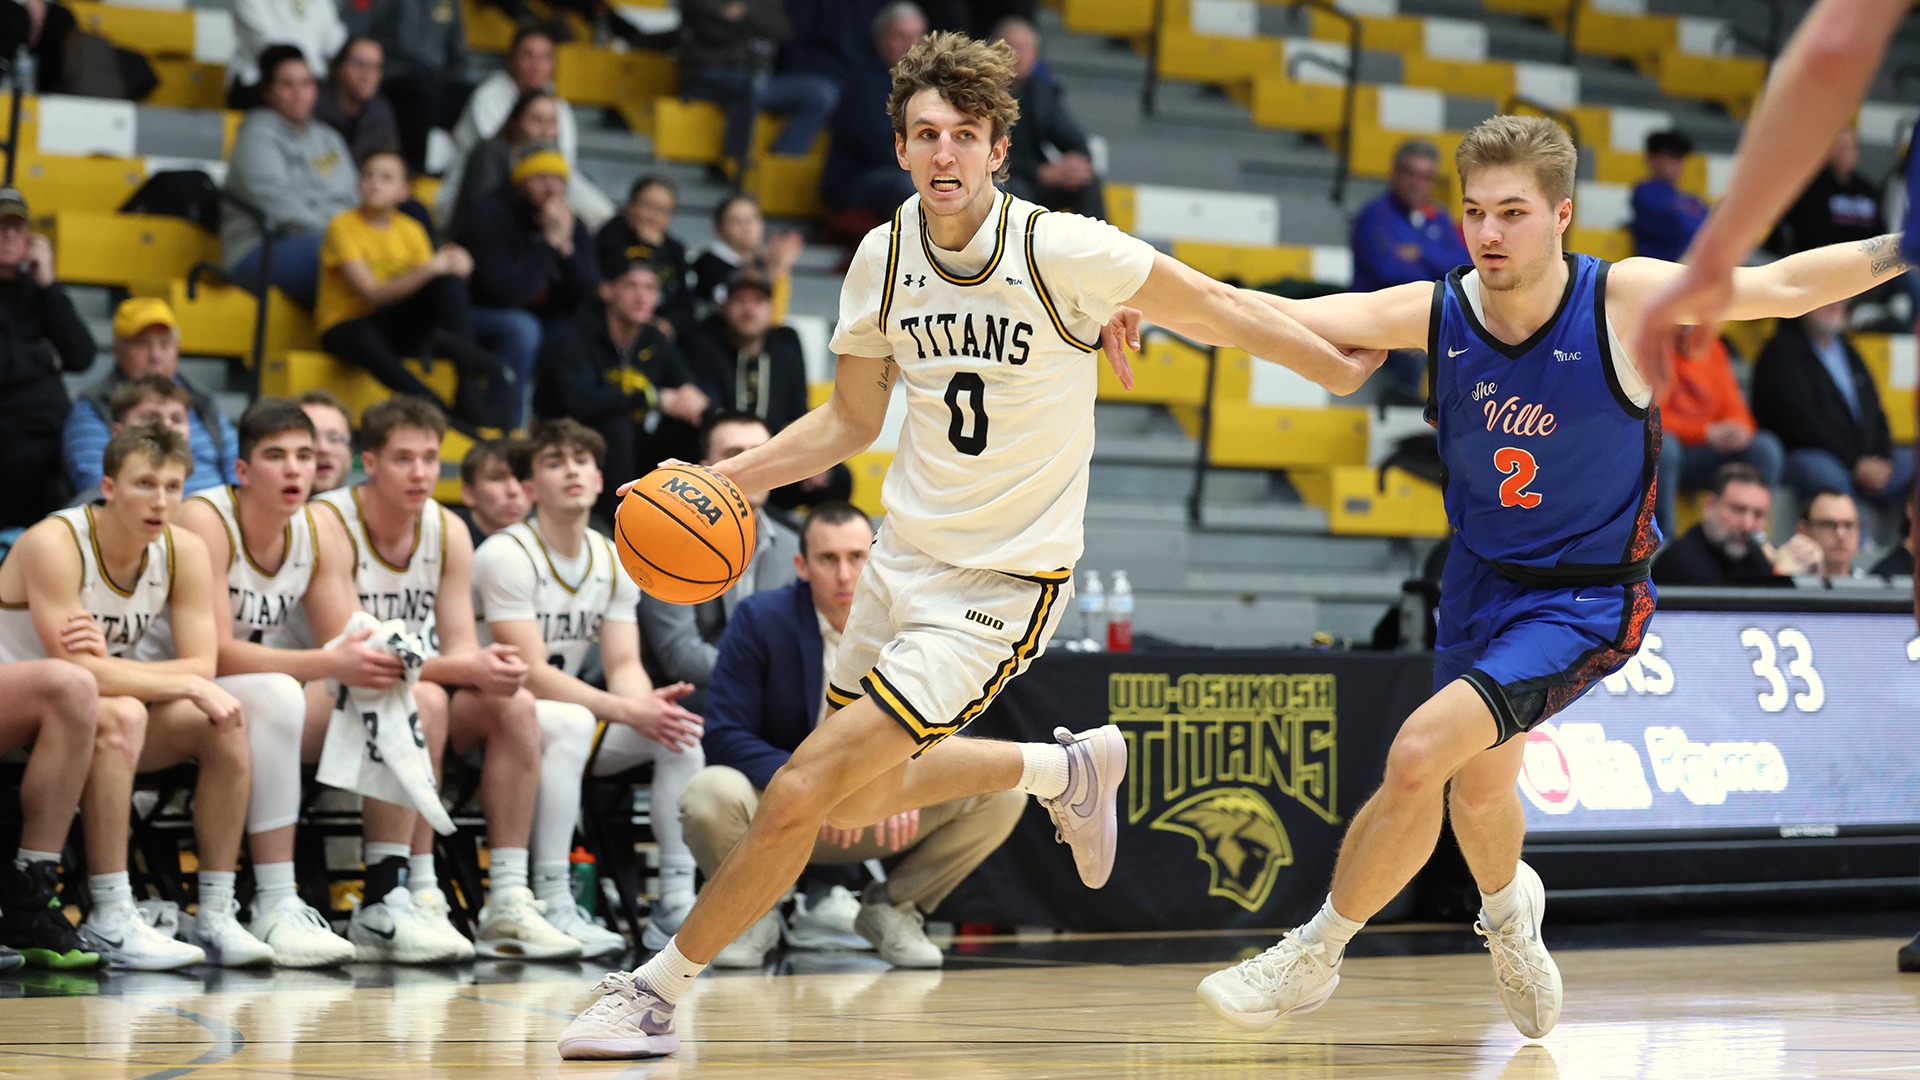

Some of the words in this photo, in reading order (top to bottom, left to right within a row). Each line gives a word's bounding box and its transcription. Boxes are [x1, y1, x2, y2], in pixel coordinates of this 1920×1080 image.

[900, 313, 1033, 365] TITANS
[1554, 350, 1582, 362] WIAC
[944, 371, 988, 456] 0
[1471, 381, 1498, 401] The
[1483, 396, 1557, 437] Ville
[661, 476, 723, 526] NCAA
[1493, 446, 1542, 509] 2
[965, 609, 1004, 631] UWO
[1108, 673, 1337, 714] UW-OSHKOSH
[1741, 628, 1824, 712] 33
[1109, 713, 1341, 824] TITANS
